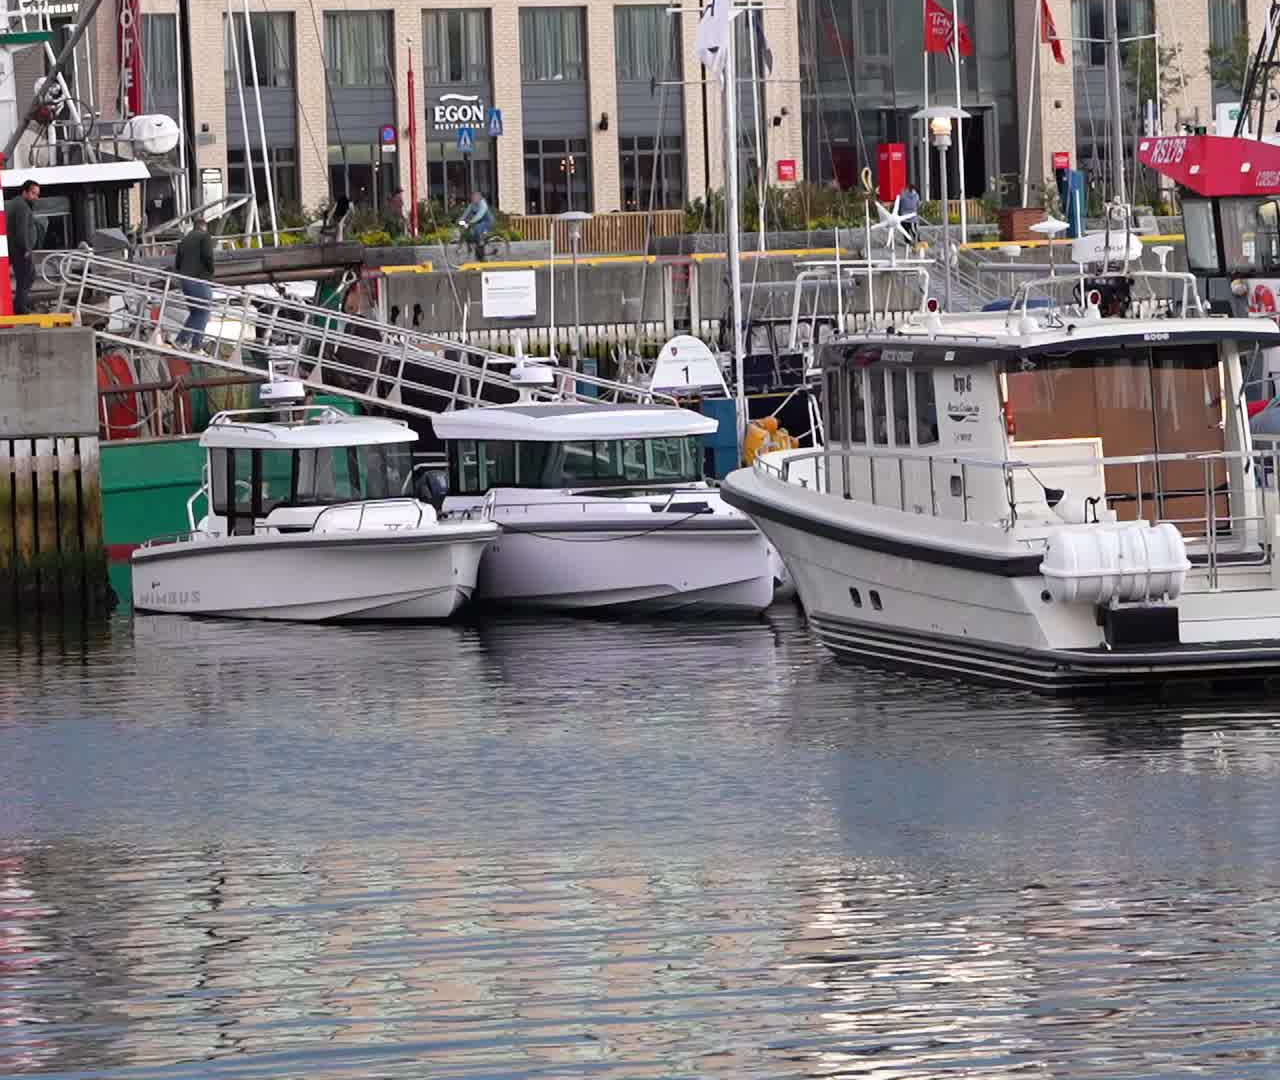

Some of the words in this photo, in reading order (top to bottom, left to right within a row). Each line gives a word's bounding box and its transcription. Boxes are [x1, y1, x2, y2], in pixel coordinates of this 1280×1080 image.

[434, 105, 485, 123] EGON
[681, 365, 690, 385] 1
[139, 590, 201, 605] NIMBUS
